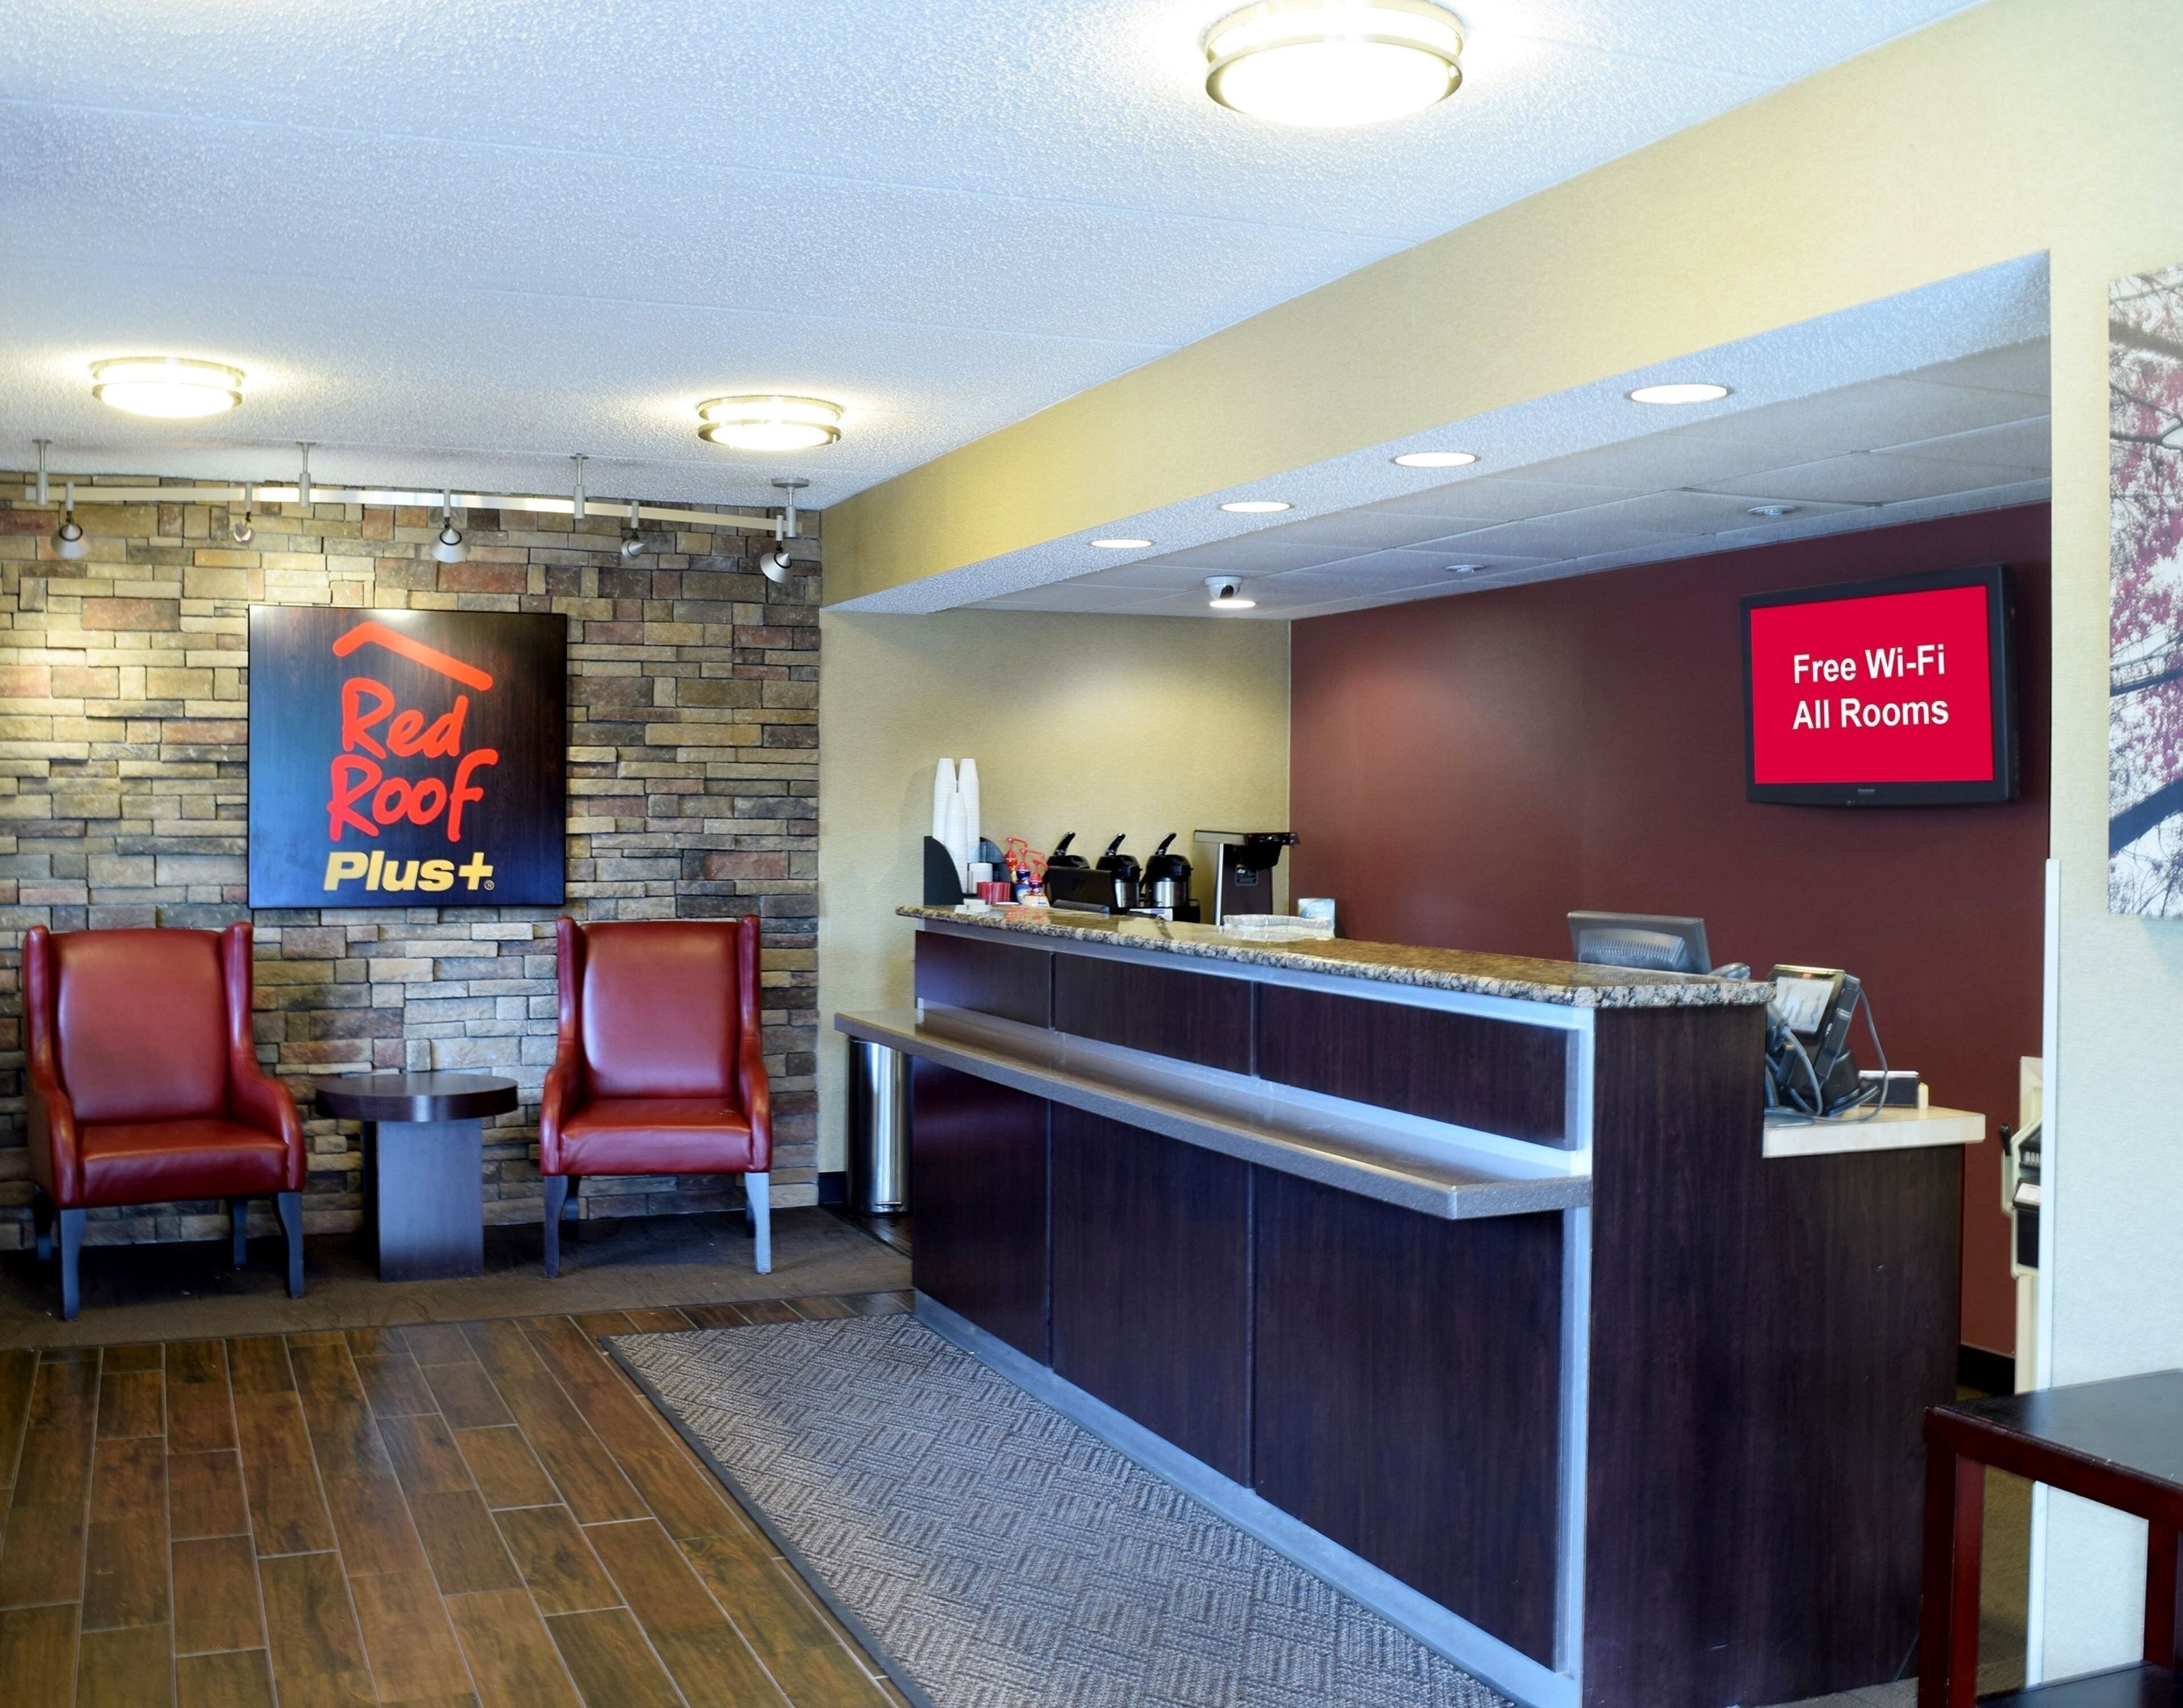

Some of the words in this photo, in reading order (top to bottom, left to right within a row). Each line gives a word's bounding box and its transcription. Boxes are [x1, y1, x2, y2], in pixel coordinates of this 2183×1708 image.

[1793, 654, 1857, 684] Free
[1865, 643, 1946, 679] Wi-Fi
[342, 677, 469, 760] Red
[1792, 699, 1831, 730] All
[1840, 698, 1950, 728] Rooms
[327, 748, 499, 842] Roof
